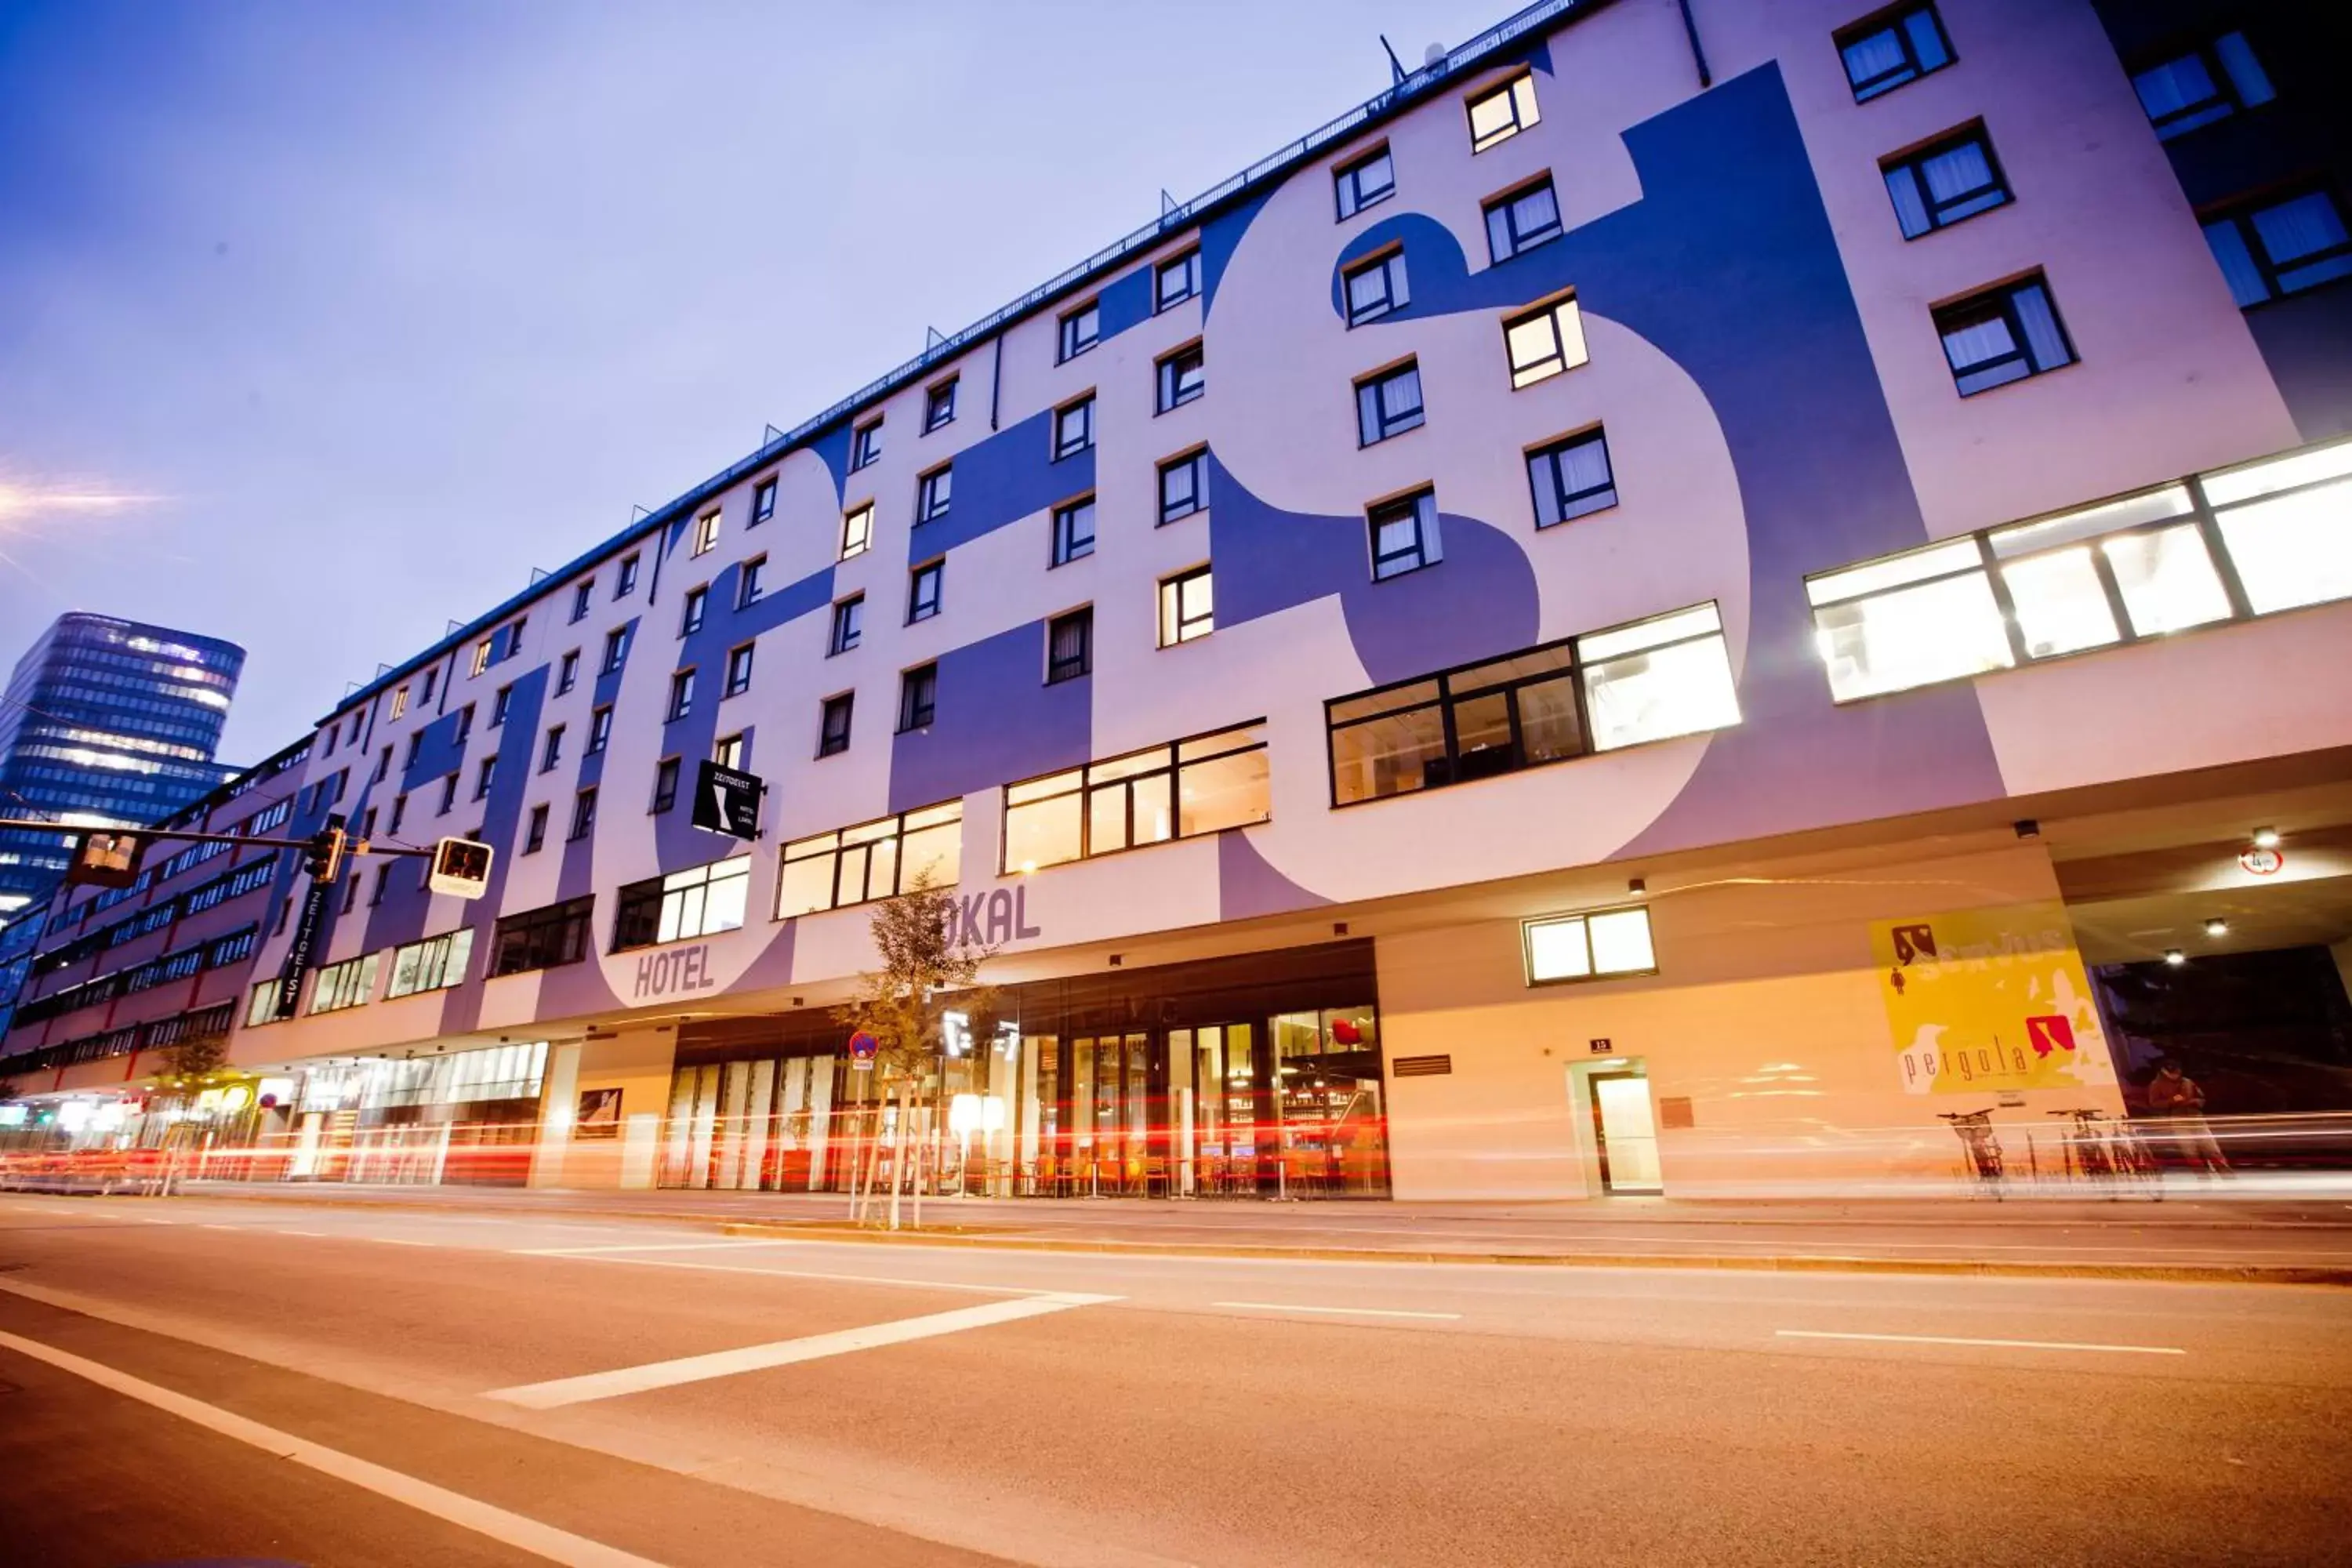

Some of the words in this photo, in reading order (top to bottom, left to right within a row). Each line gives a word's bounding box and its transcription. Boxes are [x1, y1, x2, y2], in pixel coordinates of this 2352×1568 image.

[285, 891, 322, 1004] ZEITGEIST
[927, 884, 1041, 952] OKAL
[633, 944, 714, 998] HOTEL
[1904, 1033, 2027, 1085] pergola
